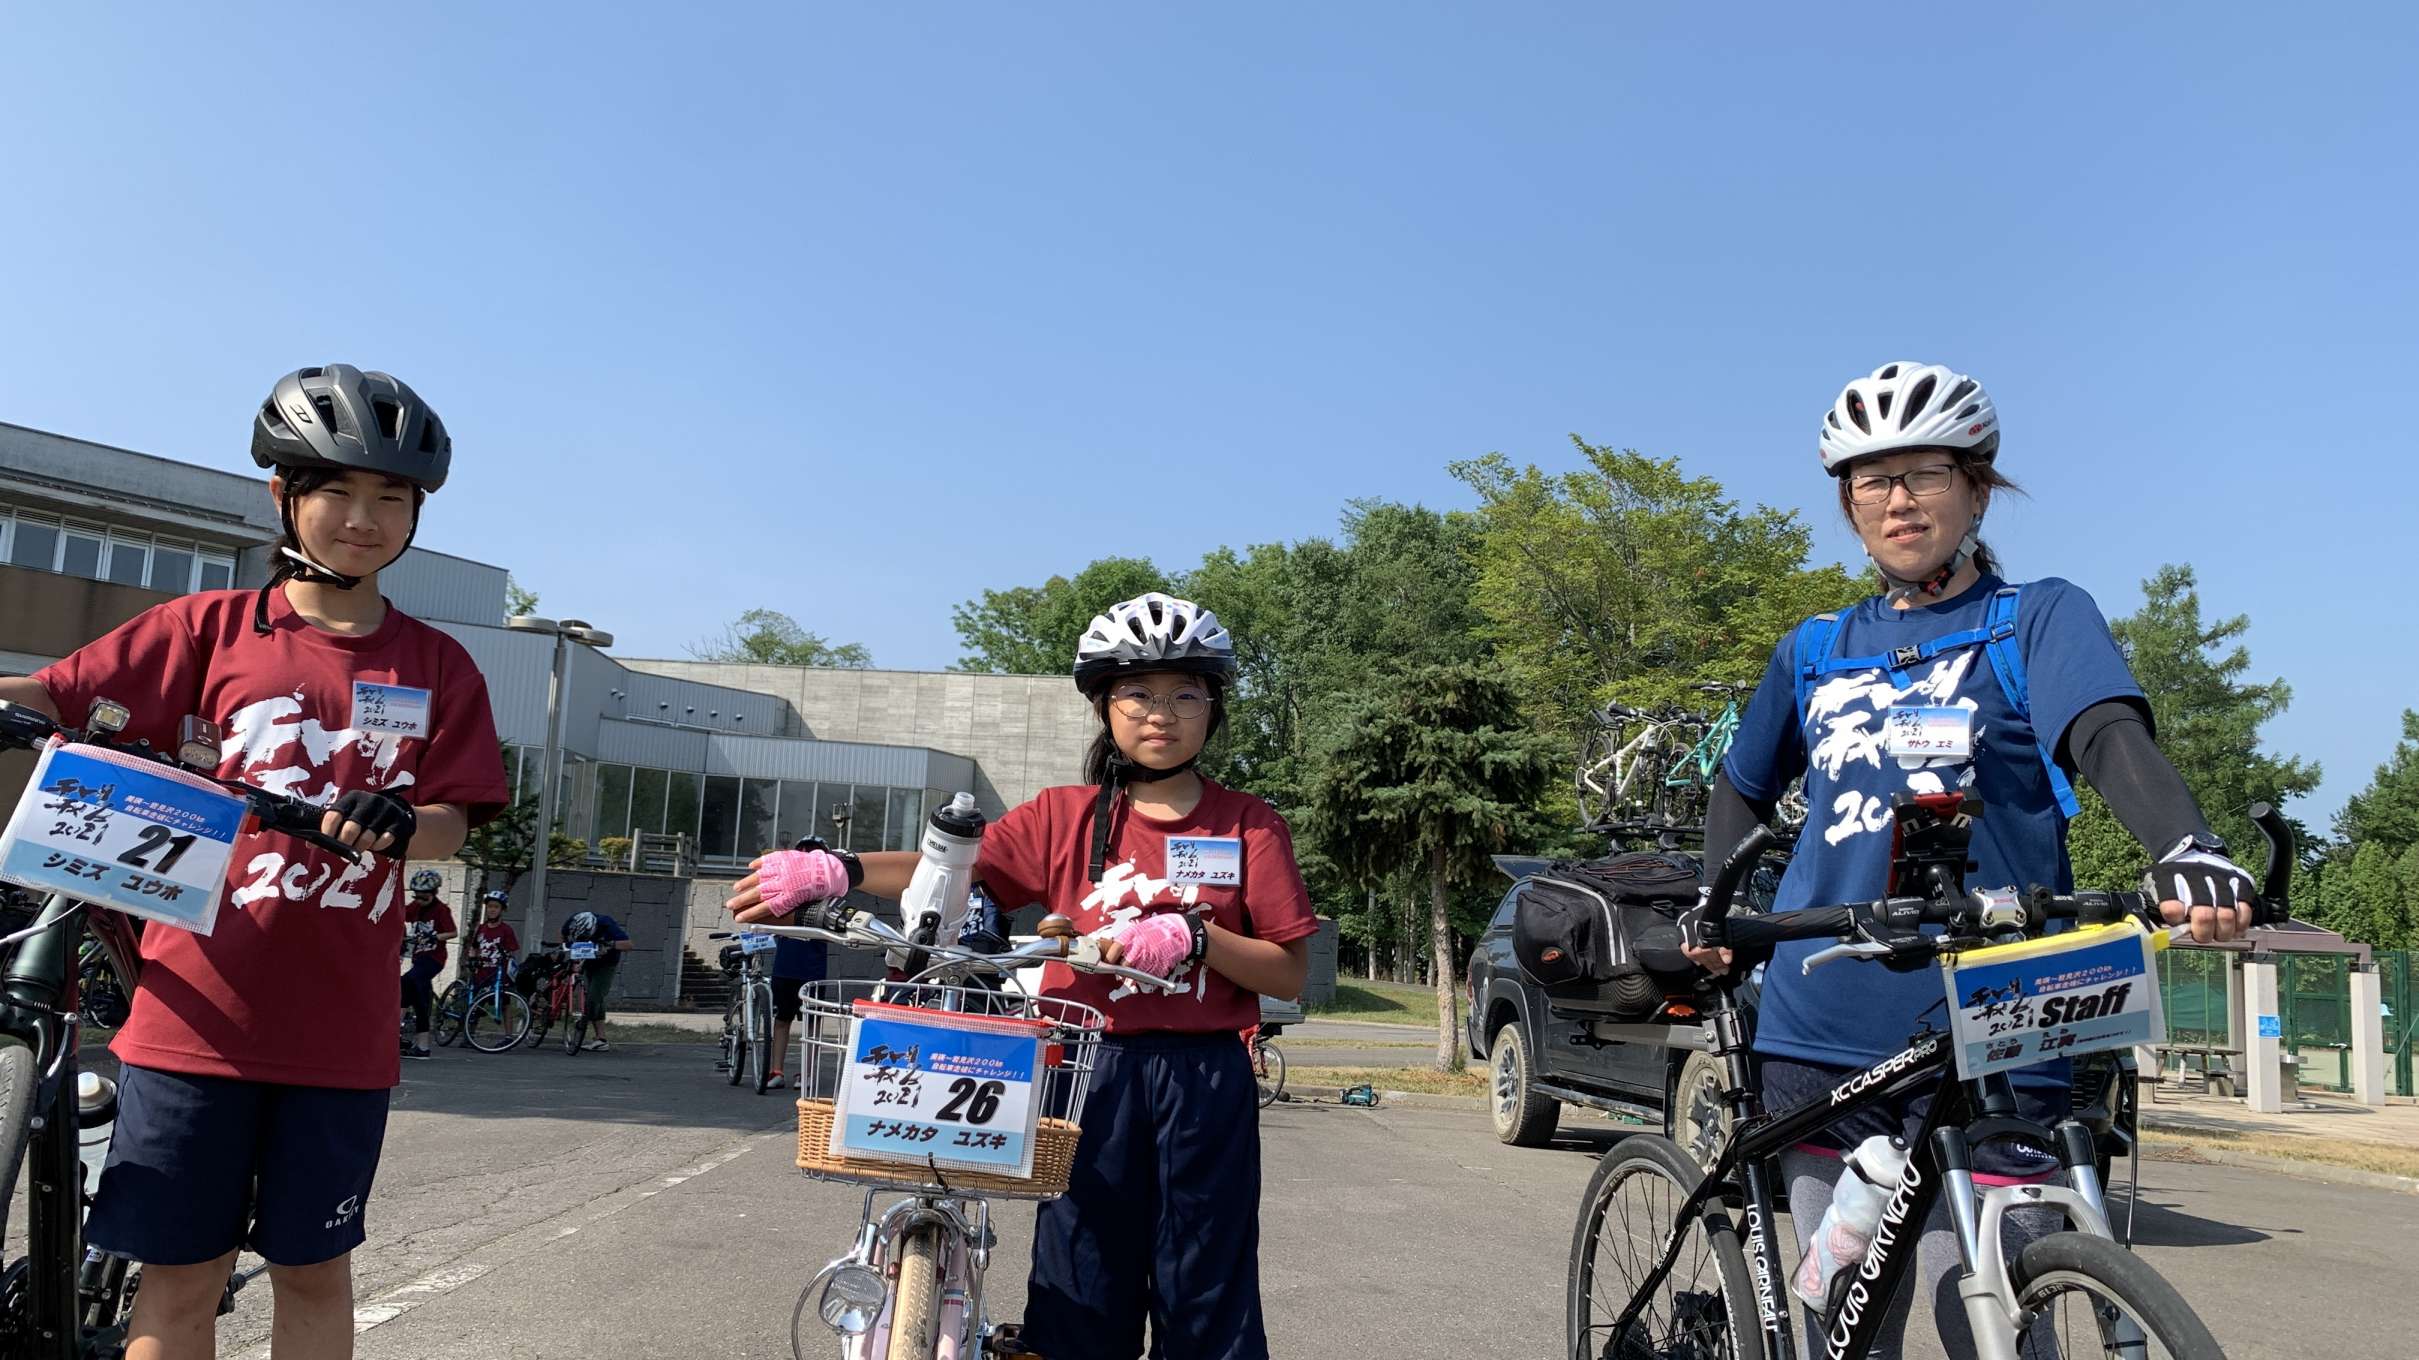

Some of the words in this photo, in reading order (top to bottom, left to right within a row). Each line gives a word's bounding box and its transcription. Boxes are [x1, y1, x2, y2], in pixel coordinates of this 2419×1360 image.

[363, 716, 390, 727] シミズ
[1908, 740, 1930, 748] サトウ
[1936, 740, 1953, 748] エミ
[49, 821, 109, 846] 2021
[117, 824, 198, 875] 21
[43, 852, 111, 881] シミズ
[120, 874, 184, 901] ユウホ
[231, 850, 400, 925] 2021
[1176, 870, 1206, 879] ナメカタ
[1211, 871, 1236, 881] ユズキ
[1988, 1008, 2034, 1037] 2021
[2037, 982, 2132, 1029] Staff
[1831, 1081, 1851, 1106] XC
[1850, 1047, 1915, 1093] CASPER
[1914, 1039, 1937, 1061] PRO
[873, 1085, 922, 1108] 2021
[935, 1077, 1006, 1126] 26
[866, 1120, 939, 1142] ナメカタ
[952, 1131, 1008, 1151] ユズキ
[1747, 1204, 1765, 1258] LOUIS
[1755, 1258, 1778, 1332] GARNEAU
